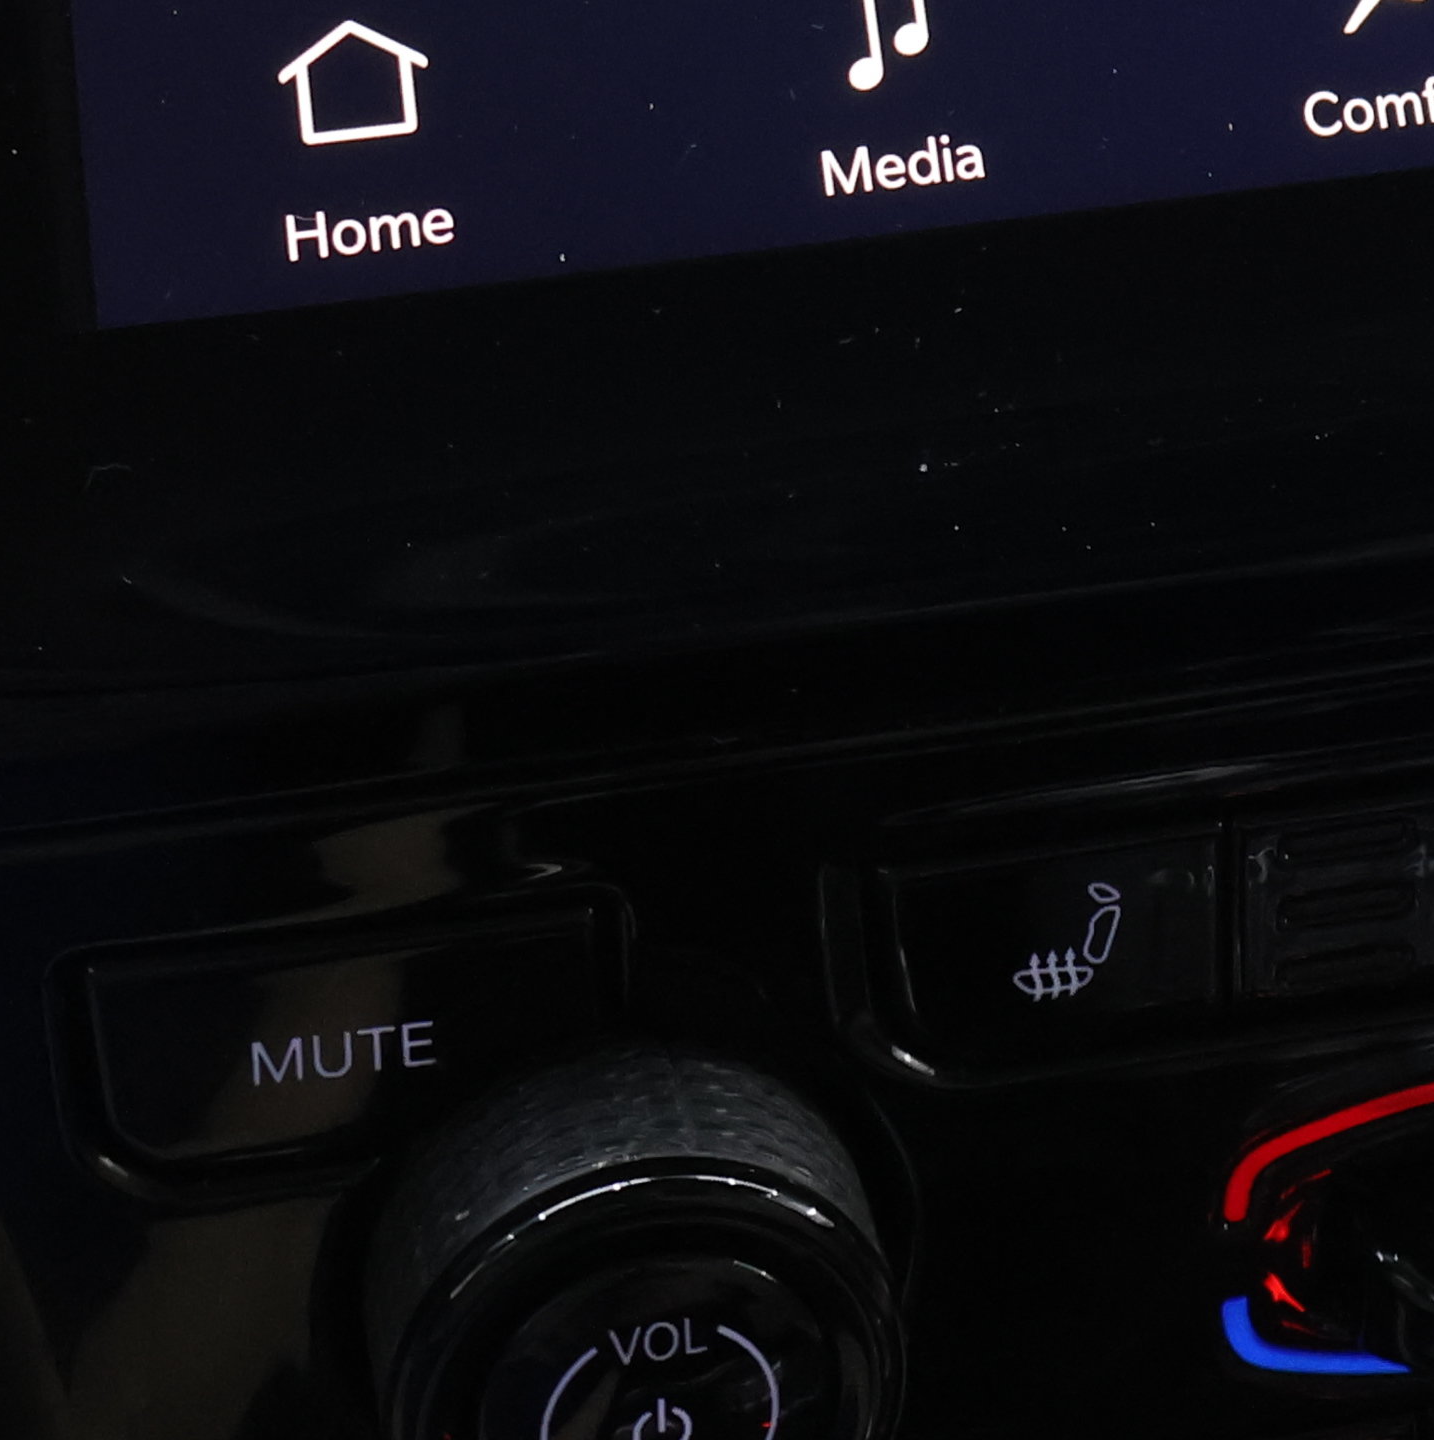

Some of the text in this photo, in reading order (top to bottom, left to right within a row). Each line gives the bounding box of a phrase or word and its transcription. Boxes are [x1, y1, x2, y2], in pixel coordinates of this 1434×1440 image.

[820, 135, 985, 197] Media
[284, 204, 455, 262] Home
[250, 1020, 437, 1087] MUTE
[608, 1318, 708, 1367] VOL
